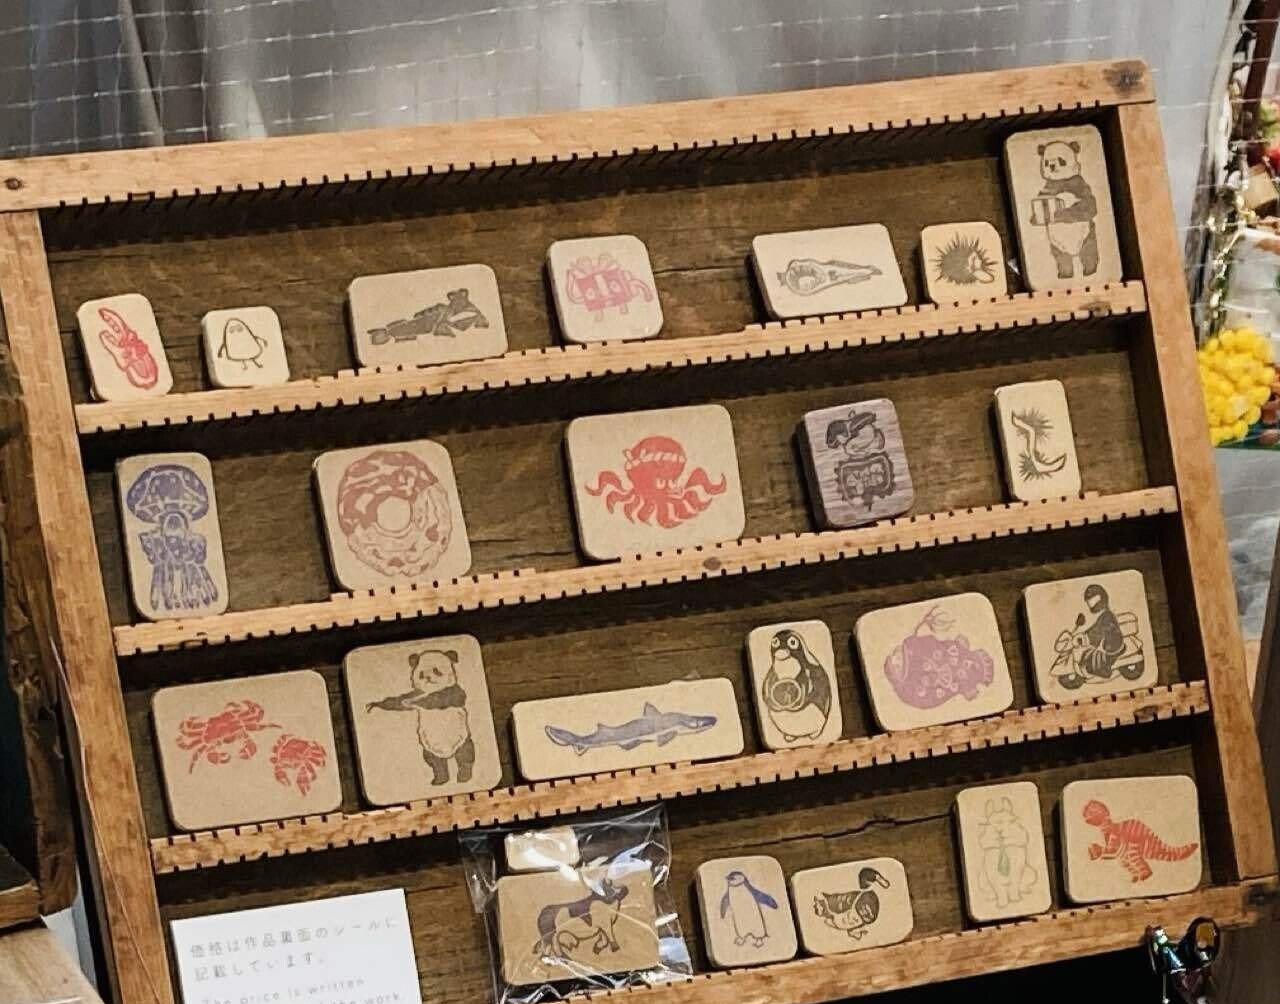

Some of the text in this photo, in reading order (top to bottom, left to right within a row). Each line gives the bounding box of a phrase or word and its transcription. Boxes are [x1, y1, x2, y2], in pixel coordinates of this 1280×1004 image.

[190, 917, 399, 959] 価格は作品裏面のシールに
[288, 986, 301, 998] is
[308, 978, 365, 996] written
